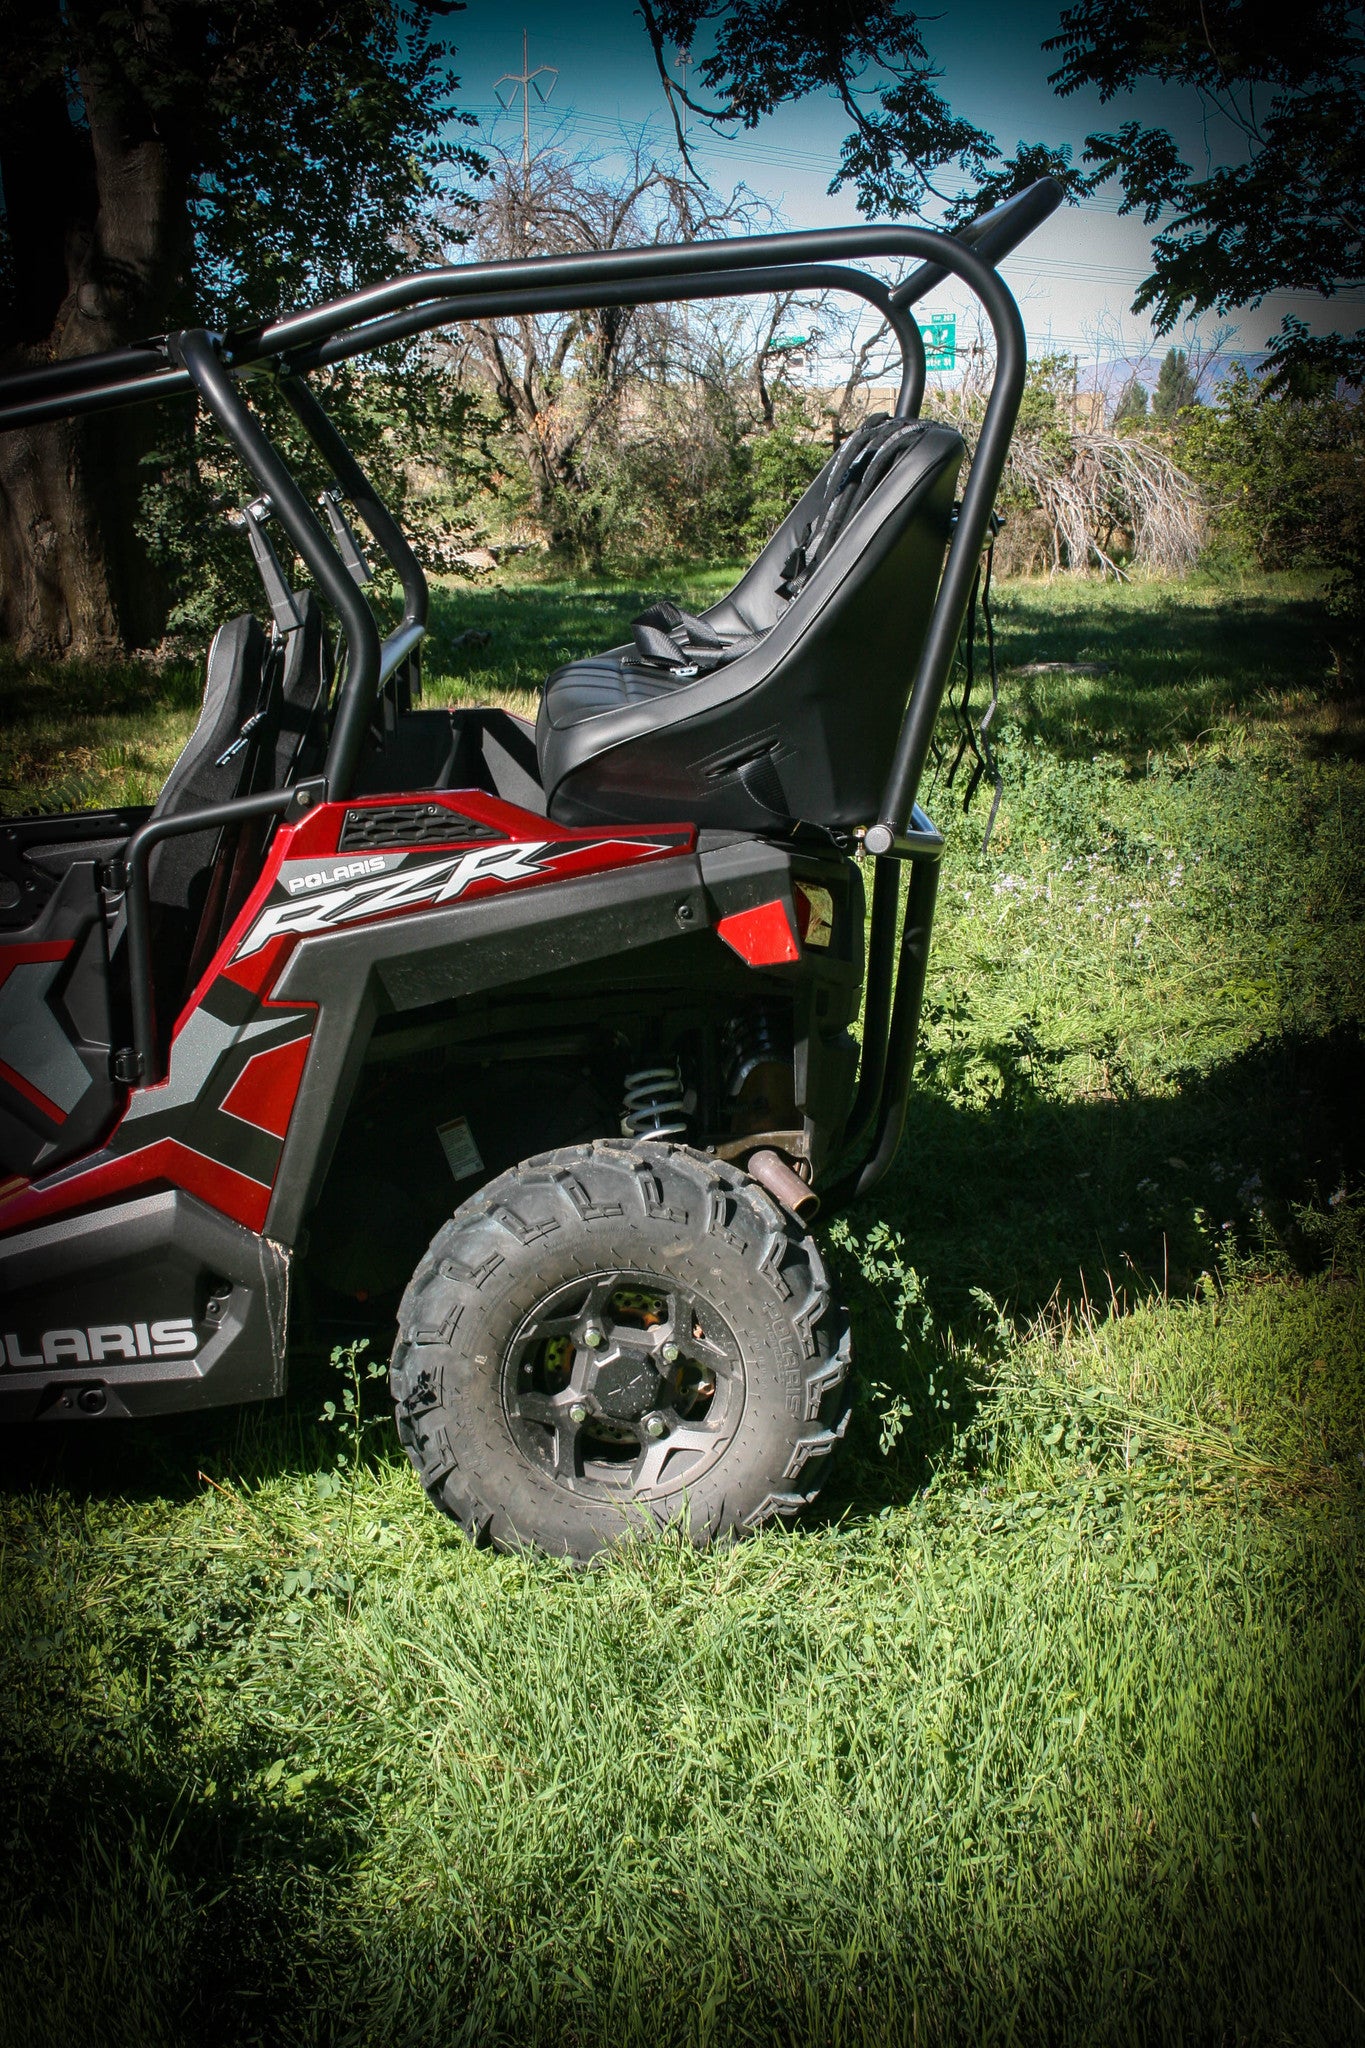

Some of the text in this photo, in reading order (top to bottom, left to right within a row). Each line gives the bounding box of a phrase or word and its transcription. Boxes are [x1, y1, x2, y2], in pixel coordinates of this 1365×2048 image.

[232, 842, 550, 962] RZR
[289, 856, 386, 895] POLARIS
[0, 1319, 198, 1368] LARIS
[763, 1300, 801, 1412] POLARIS
